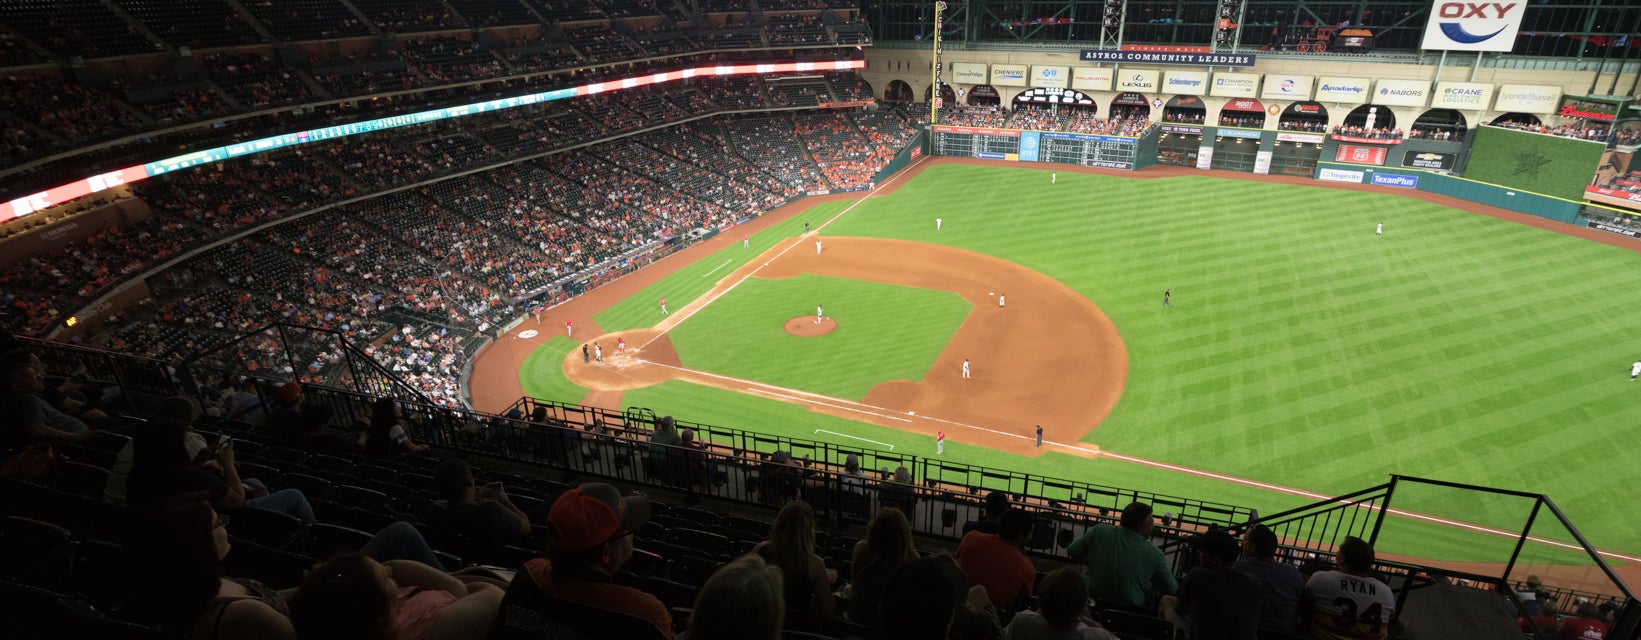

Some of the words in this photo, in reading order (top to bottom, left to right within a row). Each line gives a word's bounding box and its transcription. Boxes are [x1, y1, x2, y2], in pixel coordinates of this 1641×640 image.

[1439, 2, 1518, 19] OXY
[1128, 53, 1194, 62] COMMUNITY
[1198, 55, 1249, 64] LEADERS
[1168, 78, 1202, 87] Schlumberger
[1320, 84, 1363, 93] Anadarko
[1502, 92, 1556, 102] lyondellbasell
[1560, 105, 1616, 120] Budweiser
[1330, 172, 1361, 180] Insperity
[1374, 176, 1414, 186] TexanPlus
[1340, 579, 1376, 596] RYAN
[1333, 596, 1382, 633] 34
